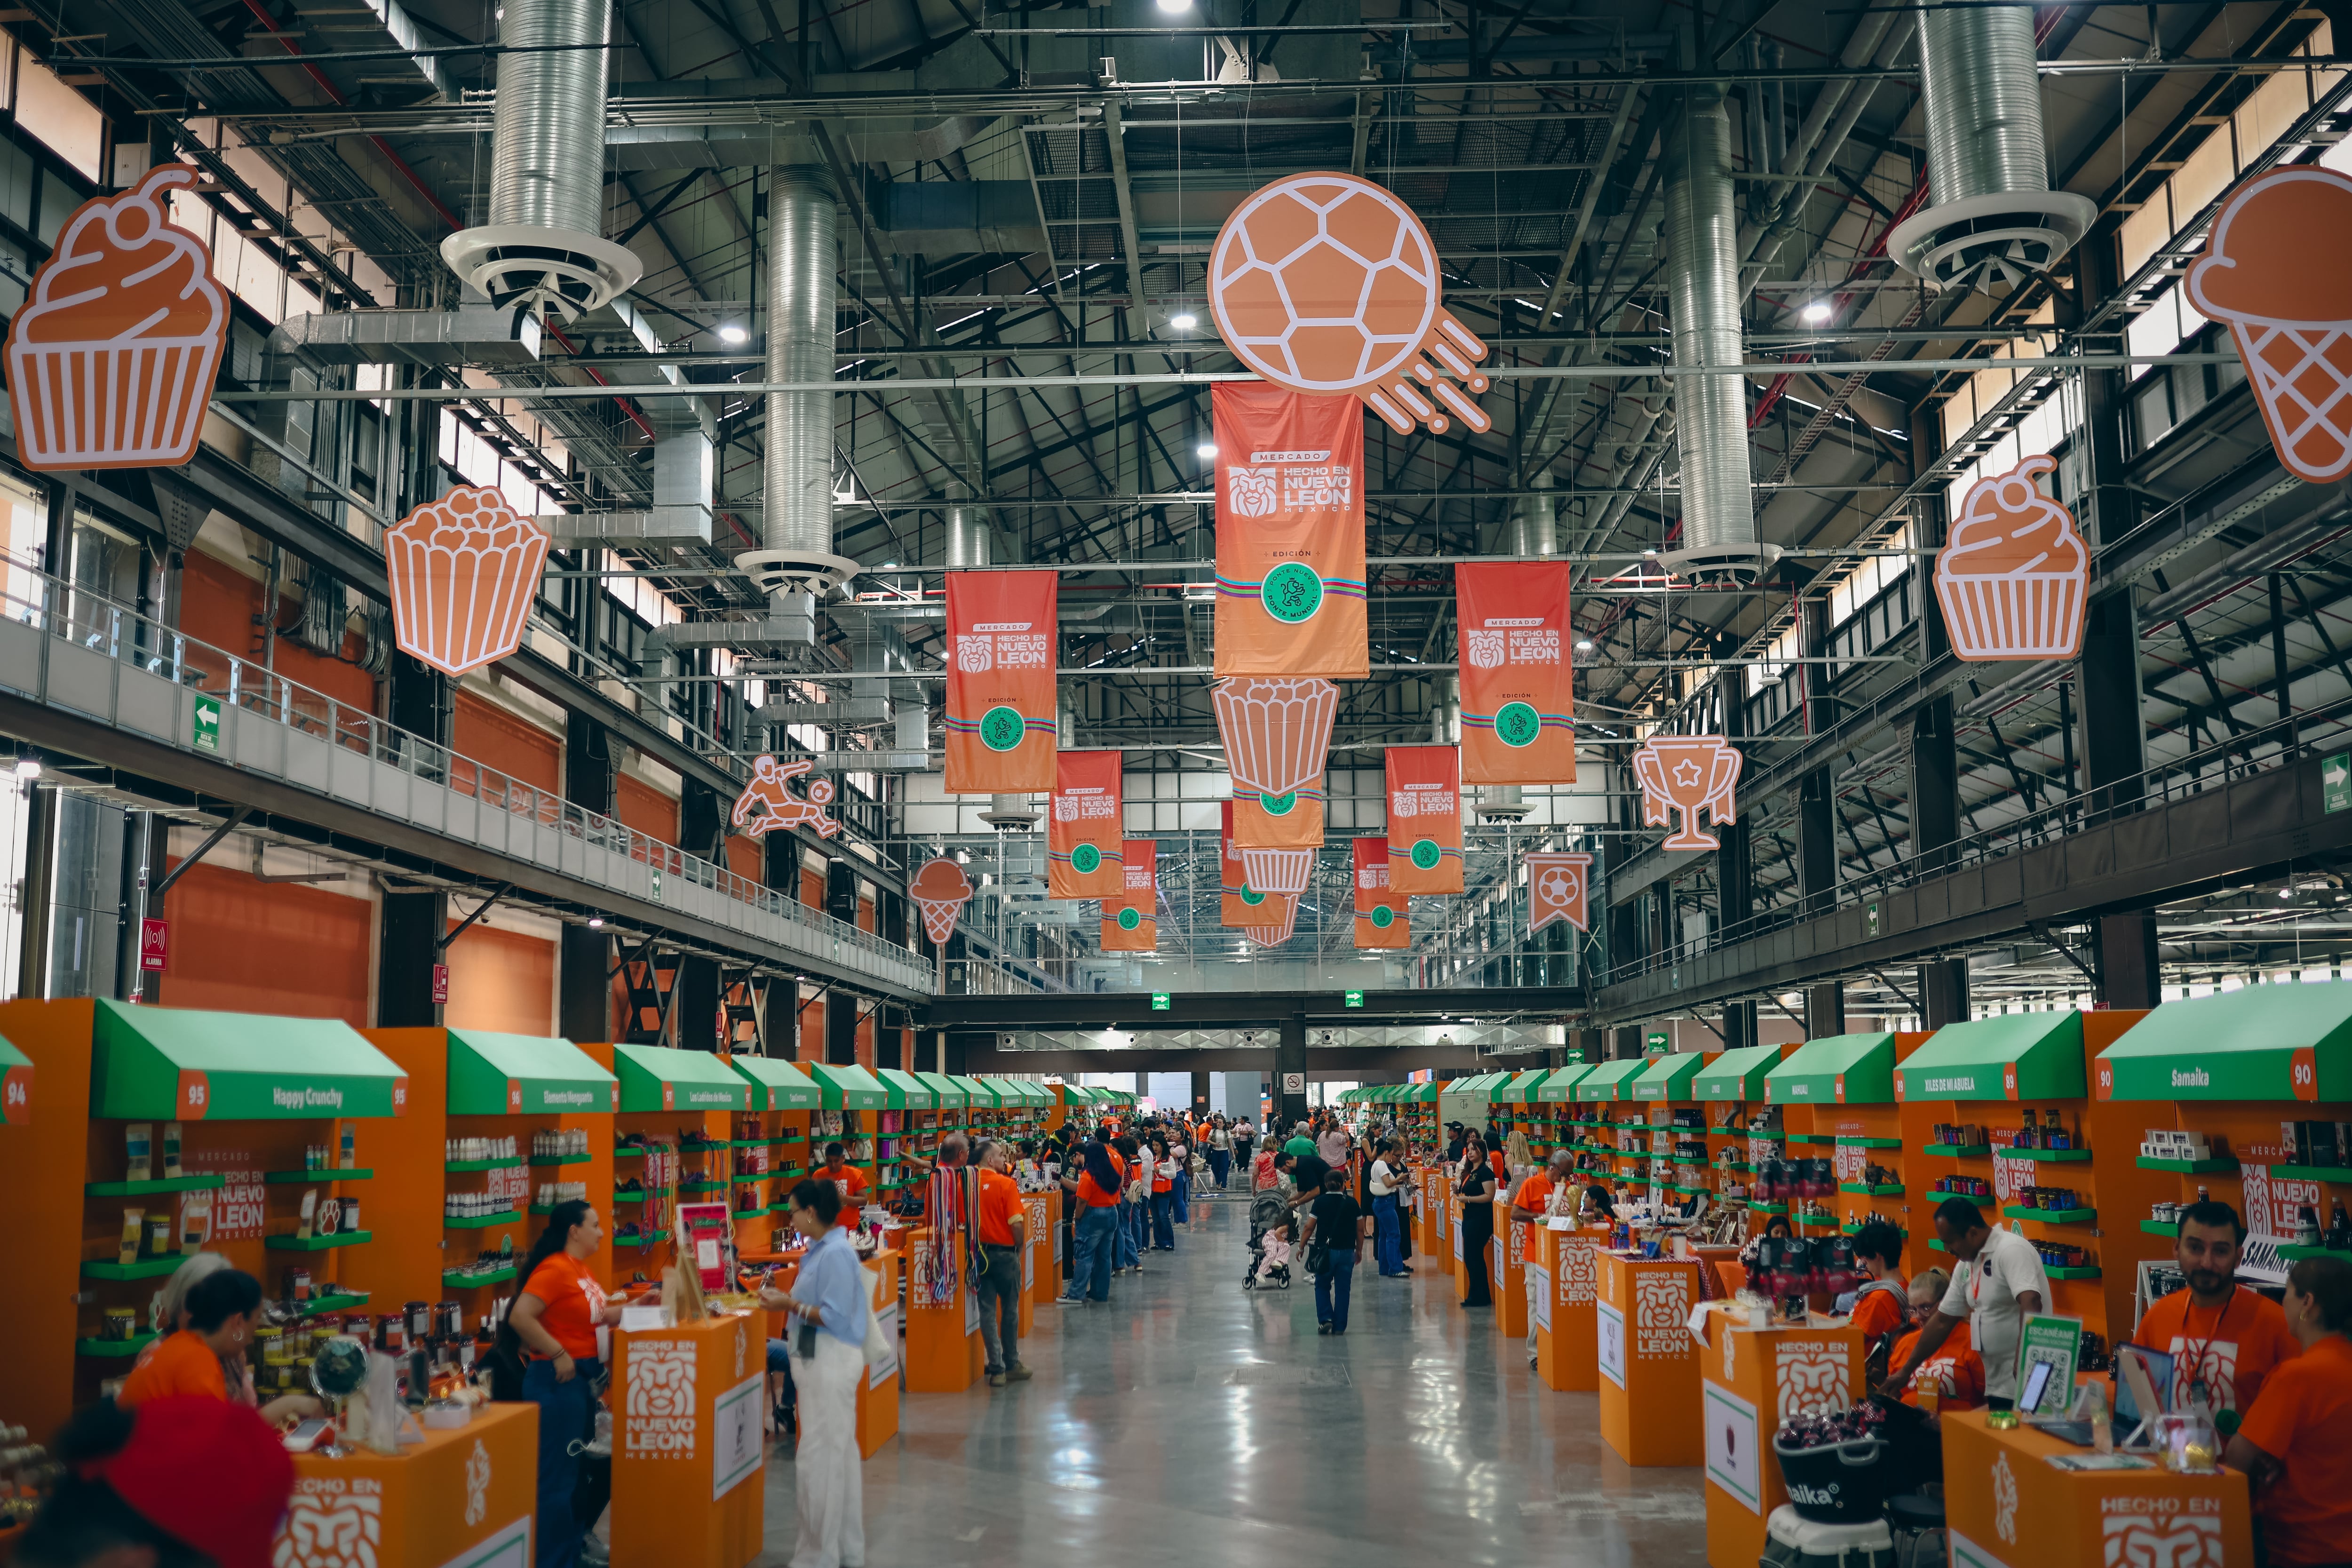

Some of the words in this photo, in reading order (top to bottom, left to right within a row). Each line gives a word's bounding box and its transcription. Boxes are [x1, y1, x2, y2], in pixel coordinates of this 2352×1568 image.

[1284, 467, 1329, 476] HECHO
[1333, 466, 1350, 475] EN
[1284, 476, 1351, 489] NUEVO
[1284, 488, 1351, 506] LEÓN
[1269, 568, 1290, 586] PONTE
[1294, 568, 1315, 585] NUEVO
[1267, 595, 1287, 617] PONTE
[1290, 595, 1318, 618] MUNDIAL
[997, 641, 1047, 651] NUEVO
[1509, 637, 1559, 647] NUEVO
[997, 651, 1046, 664] LEÓN
[1510, 646, 1559, 660] LEÓN
[985, 711, 1001, 724] PONTE
[1003, 710, 1020, 724] NUEVO
[1500, 707, 1516, 719] PONTE
[1518, 707, 1534, 719] NUEVO
[984, 730, 999, 747] PONTE
[1000, 730, 1021, 748] MUNDIAL
[1499, 726, 1514, 742] PONTE
[1515, 726, 1536, 743] MUNDIAL
[1081, 807, 1114, 816] LEÓN
[1276, 797, 1294, 813] MUNDIAL
[1420, 803, 1454, 812] LEÓN
[145, 957, 162, 966] ALARMA
[2100, 1070, 2111, 1087] 90
[2171, 1067, 2209, 1087] Samaika
[2295, 1064, 2311, 1084] 90
[1897, 1080, 1903, 1092] 89
[1924, 1079, 1939, 1092] XILES
[1939, 1079, 1947, 1091] DE
[1947, 1078, 1954, 1091] MI
[1954, 1077, 1975, 1091] ABUELA
[2005, 1075, 2014, 1089] 89
[7, 1082, 26, 1106] 94
[188, 1086, 204, 1105] 95
[666, 1091, 673, 1102] 97
[1836, 1084, 1842, 1095] 88
[273, 1087, 304, 1110] Happy
[305, 1087, 342, 1109] Crunchy
[394, 1089, 405, 1105] 95
[511, 1091, 520, 1105] 96
[543, 1091, 567, 1104] Elemento
[567, 1090, 594, 1106] Menguante
[612, 1091, 618, 1103] 96
[746, 1093, 751, 1103] 97
[198, 1152, 249, 1161] MERCADO
[1848, 1145, 1866, 1156] NUEVO
[2251, 1146, 2283, 1156] MERCA
[2008, 1158, 2034, 1172] NUEVO
[252, 1171, 264, 1182] EN
[505, 1165, 528, 1180] NUEVO
[2009, 1171, 2035, 1191] LEÓN
[218, 1185, 264, 1203] NUEVO
[505, 1179, 528, 1199] LEÓN
[2272, 1181, 2319, 1204] NUEVO
[216, 1204, 264, 1230] LEÓN
[1637, 1329, 1689, 1339] NUEVO
[2028, 1326, 2075, 1340] ESCANÉAME
[627, 1341, 673, 1351] HECHO
[676, 1341, 696, 1351] EN
[1638, 1339, 1689, 1353] LEÓN
[1776, 1342, 1824, 1353] HECHO
[1828, 1342, 1849, 1352] EN
[626, 1418, 696, 1432] NUEVO
[626, 1432, 694, 1450] LEÓN
[625, 1450, 694, 1459] MÉXICO
[294, 1477, 346, 1494] ECHO
[352, 1478, 382, 1494] EN
[2100, 1497, 2181, 1513] HECHO
[2188, 1497, 2220, 1513] EN
